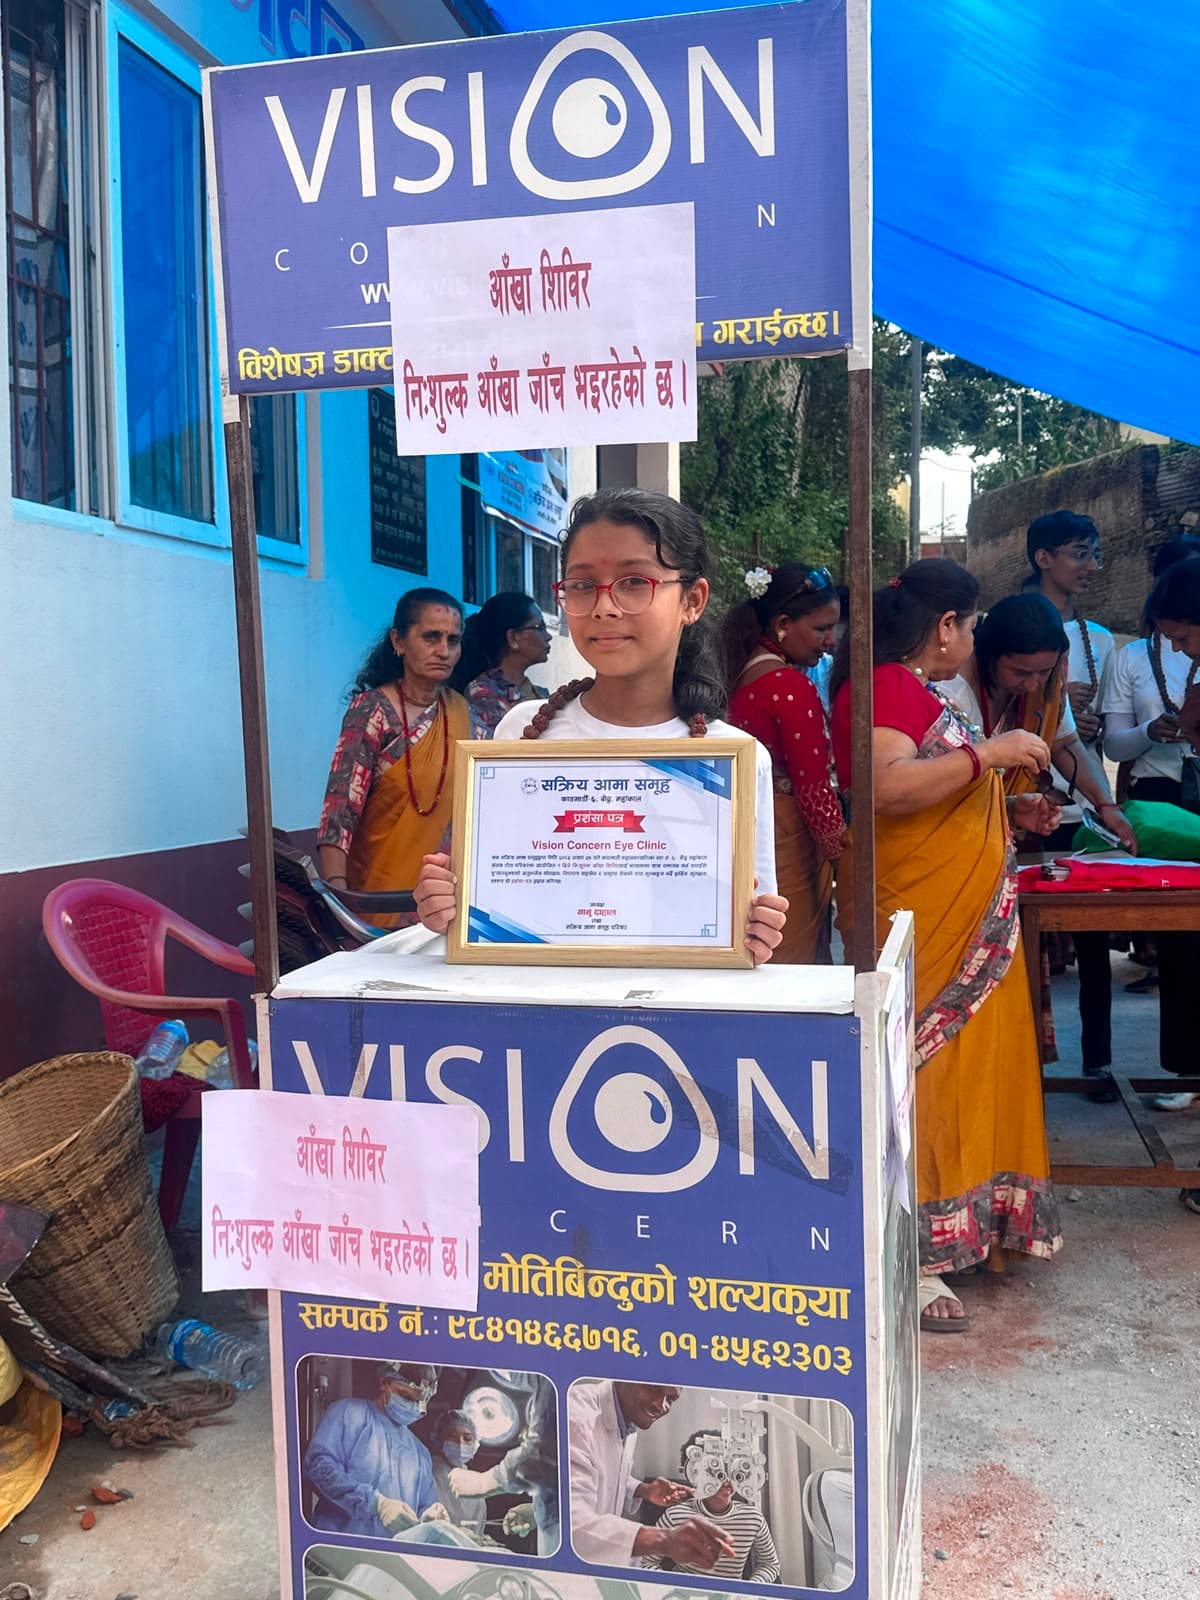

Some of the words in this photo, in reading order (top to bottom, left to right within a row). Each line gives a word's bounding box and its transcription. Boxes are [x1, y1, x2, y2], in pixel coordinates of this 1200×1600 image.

[265, 30, 776, 203] VISION
[489, 252, 532, 316] आँखा
[540, 247, 592, 312] शिविर
[238, 346, 326, 381] विशेषज्ञ
[333, 346, 394, 375] डाक्ट
[477, 354, 520, 417] आँखा
[528, 351, 566, 412] जाँच
[574, 345, 647, 414] भइरहेको
[541, 776, 589, 793] सक्रिय
[594, 778, 629, 792] आमा
[634, 778, 672, 795] समूह
[532, 840, 564, 850] Vision
[567, 840, 611, 850] Concern
[614, 840, 634, 852] Eye
[637, 840, 667, 850] Clinic
[296, 1122, 336, 1178] आँखा
[342, 1125, 387, 1183] शिविर
[282, 1208, 322, 1264] आँखा
[328, 1212, 363, 1267] जाँच
[370, 1219, 434, 1277] भइरहेको
[299, 1301, 389, 1333] सम्पर्क
